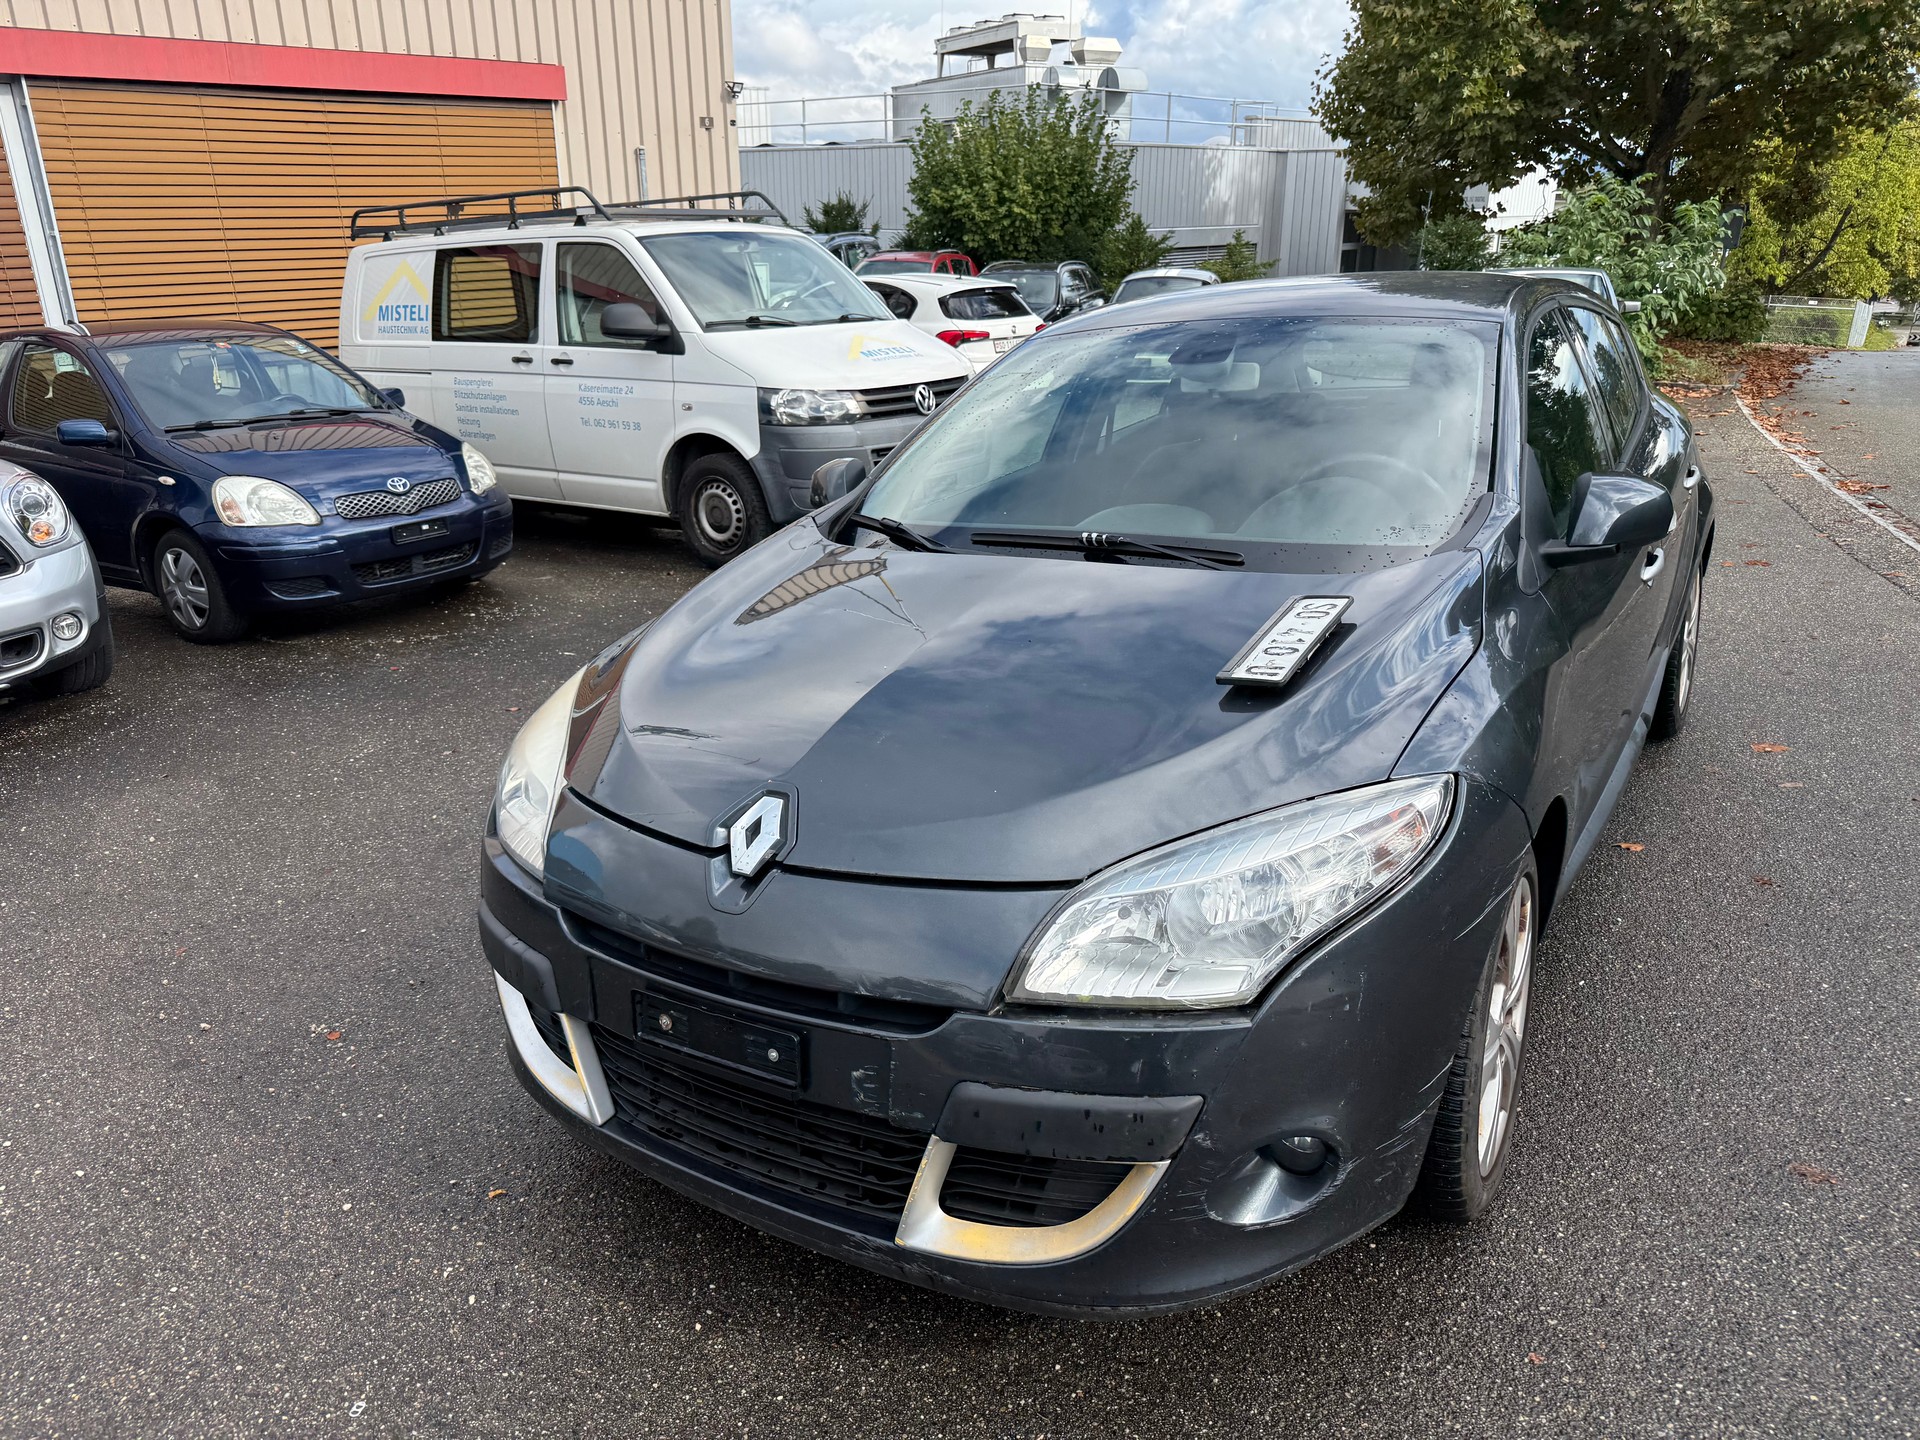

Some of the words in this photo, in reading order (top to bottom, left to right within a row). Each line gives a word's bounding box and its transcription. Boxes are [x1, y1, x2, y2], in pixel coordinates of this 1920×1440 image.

[705, 118, 709, 126] 6
[378, 304, 429, 321] MISTELI
[378, 325, 418, 334] HAUSTECHNIK
[420, 325, 429, 334] AG
[860, 346, 916, 357] MISTELI
[454, 376, 494, 388] Bauspenglerei
[579, 383, 623, 394] Käsereimatte
[624, 385, 634, 395] 24
[454, 390, 507, 403] Blitzschutzanlagen
[578, 396, 594, 406] 4556
[596, 397, 619, 408] Aeschi
[455, 403, 478, 413] Sanitäre
[457, 416, 480, 428] Heizung
[580, 417, 592, 427] Tel.
[593, 418, 606, 428] 062
[607, 419, 620, 429] 961
[621, 420, 631, 430] 59
[632, 421, 641, 431] 38
[459, 429, 496, 441] Solaranlagen
